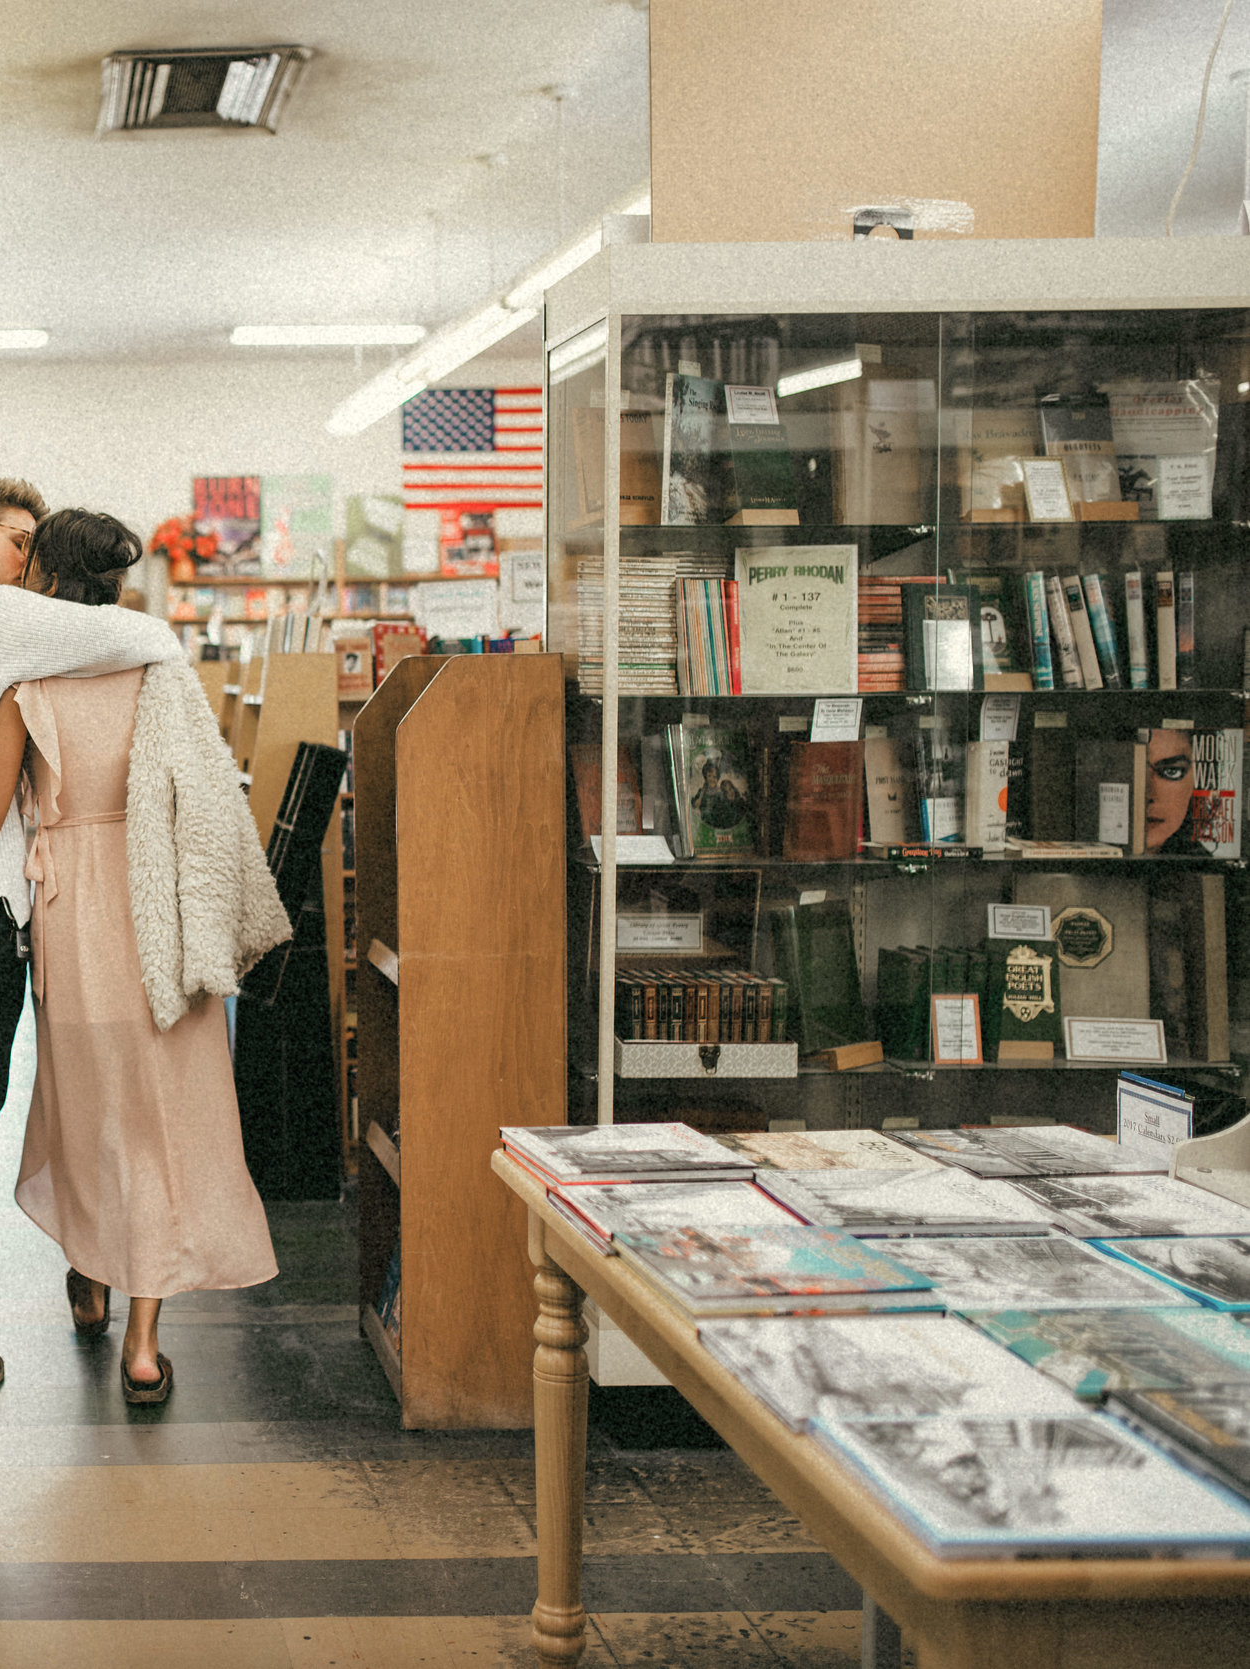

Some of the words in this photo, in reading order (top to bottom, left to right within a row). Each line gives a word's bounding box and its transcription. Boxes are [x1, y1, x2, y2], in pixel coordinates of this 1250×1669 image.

[749, 566, 789, 586] PERRY
[793, 565, 845, 584] RHODAN
[772, 593, 778, 602] #
[783, 593, 788, 601] 1
[802, 593, 821, 601] 137
[1193, 734, 1237, 762] MOON
[1193, 762, 1236, 790] WALK
[1192, 797, 1235, 821] MICHAEL
[1191, 821, 1235, 843] JACKSON
[1006, 973, 1043, 983] ENGLISH
[1007, 966, 1040, 974] GREAT
[1008, 982, 1042, 991] POETS
[1144, 1111, 1160, 1125] Small
[1123, 1118, 1137, 1131] 2017
[1138, 1123, 1166, 1141] Calendars
[858, 1141, 912, 1163] Berlin
